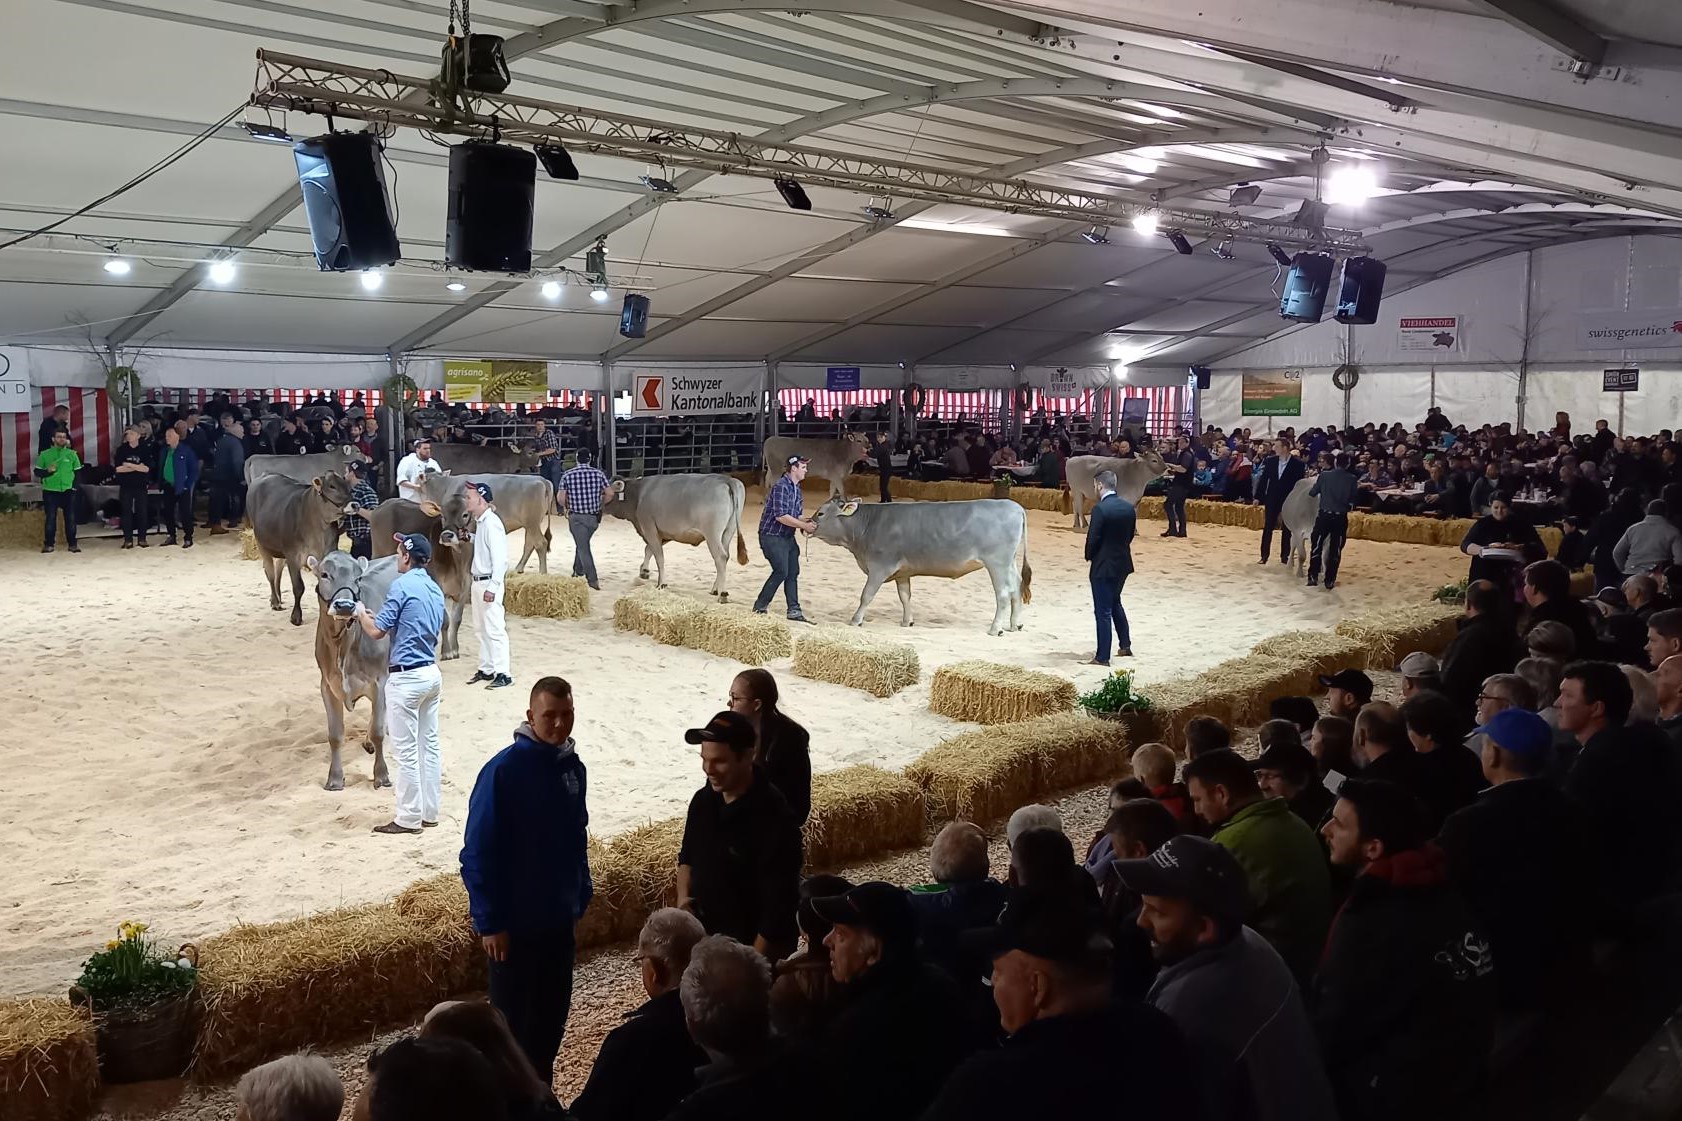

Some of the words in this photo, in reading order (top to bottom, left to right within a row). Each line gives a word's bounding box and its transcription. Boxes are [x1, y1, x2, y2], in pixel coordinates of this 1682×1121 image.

[1402, 319, 1454, 327] VIEHHANDEL
[1588, 324, 1667, 340] swissgenetics
[447, 367, 484, 378] agrisano
[671, 376, 722, 393] Schwyzer
[1051, 382, 1072, 392] SWISS
[671, 391, 757, 410] Kantonalbank
